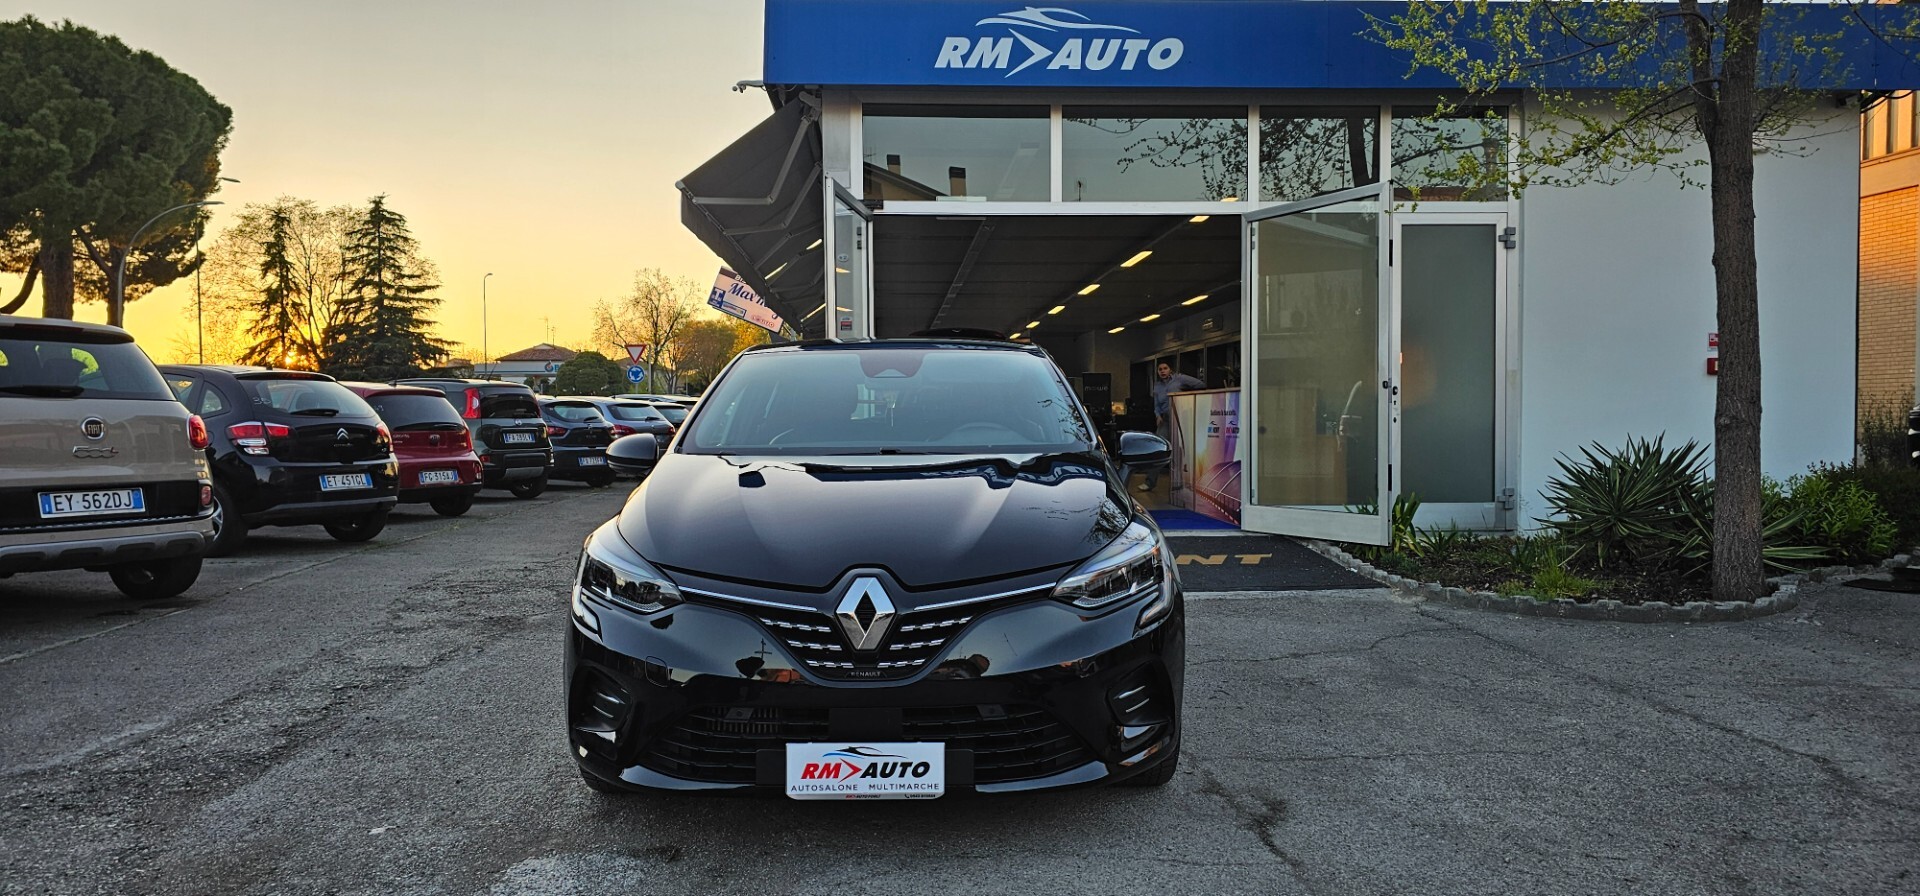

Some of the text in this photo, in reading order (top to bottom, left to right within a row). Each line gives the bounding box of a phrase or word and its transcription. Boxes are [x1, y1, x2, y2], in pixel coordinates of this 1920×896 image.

[934, 36, 1184, 71] RM AUTO
[87, 424, 100, 435] FIAT
[326, 475, 337, 487] ET
[53, 493, 74, 512] EY
[82, 491, 132, 510] 562DJ
[1175, 552, 1273, 565] NT
[800, 761, 931, 780] RM AUTO
[791, 783, 939, 792] AUTOSALONE MULTIMARCHE
